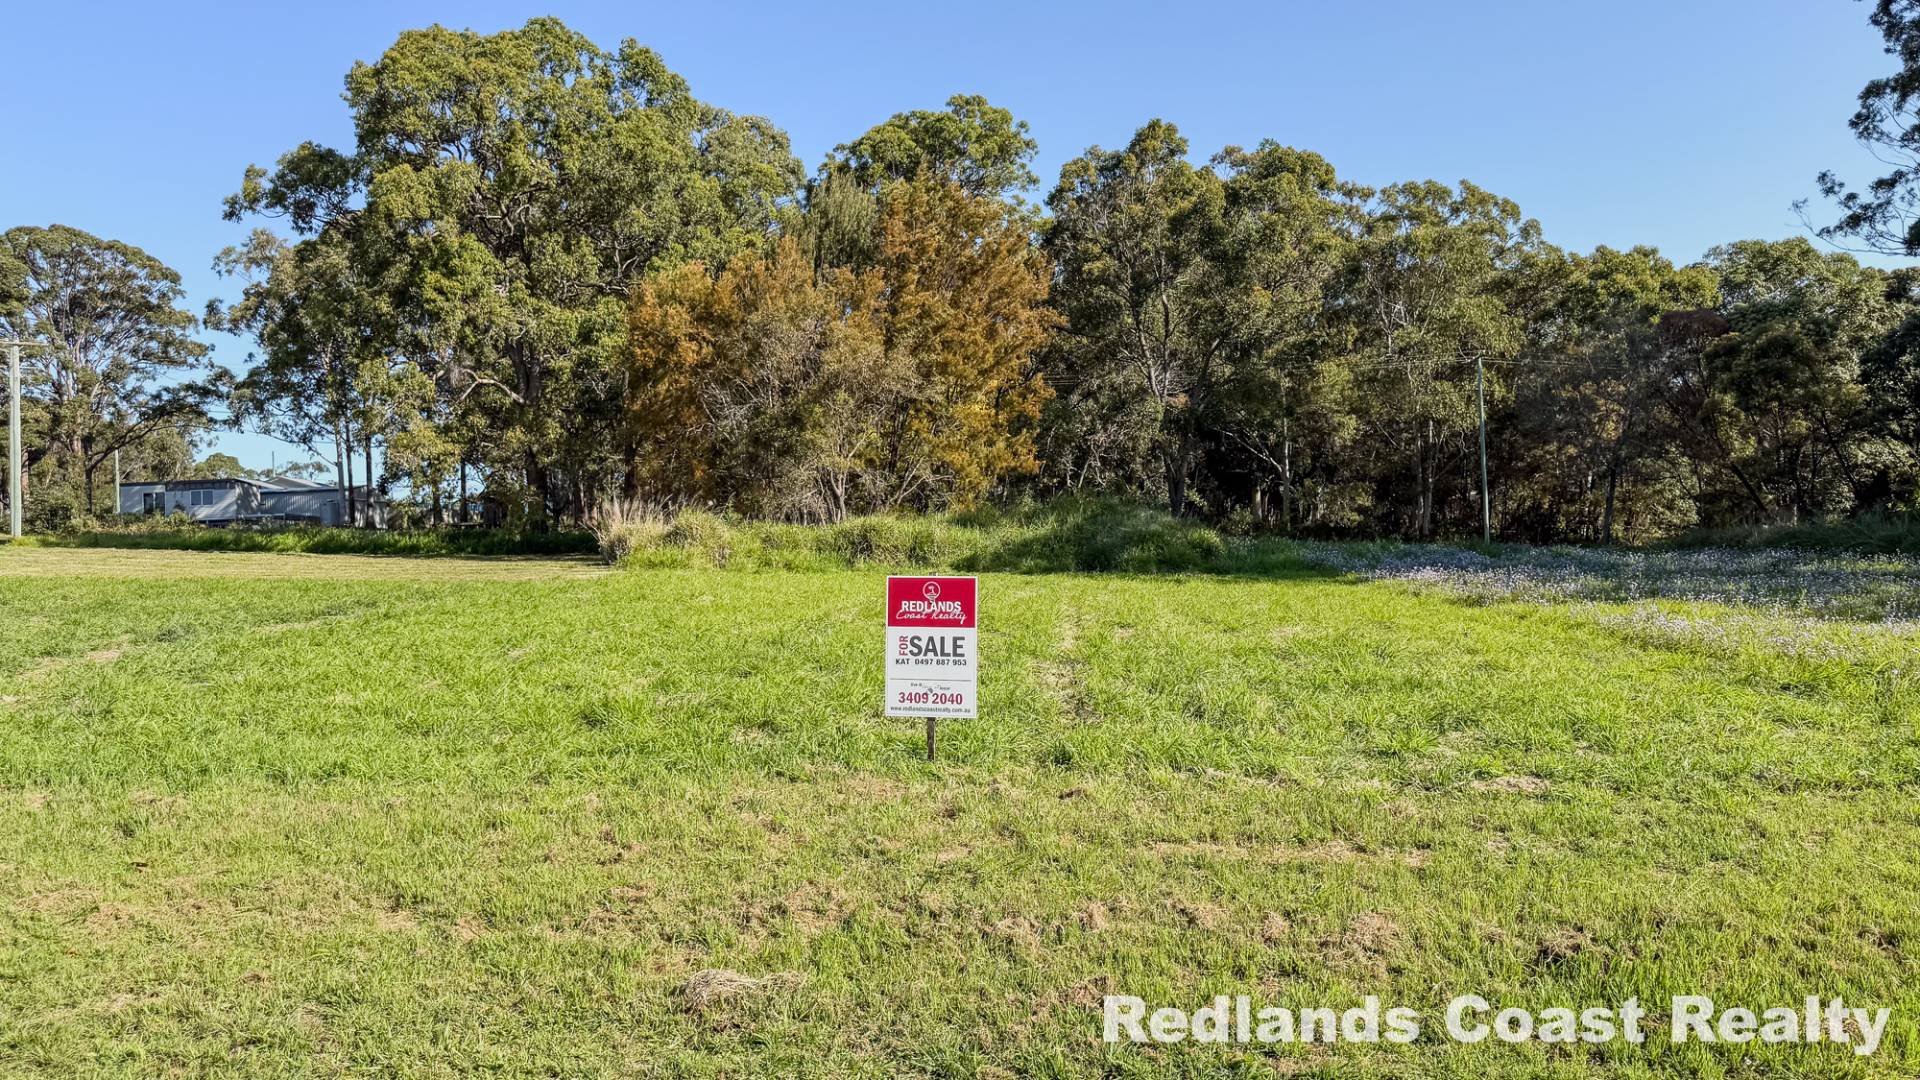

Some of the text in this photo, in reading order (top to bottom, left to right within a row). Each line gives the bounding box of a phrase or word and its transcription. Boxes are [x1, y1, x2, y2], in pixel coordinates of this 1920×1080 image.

[901, 600, 962, 613] REDLANDS
[896, 608, 967, 625] Coast Realty
[898, 635, 966, 658] FOR SALE
[895, 658, 911, 666] KAT
[914, 658, 934, 666] 0497
[898, 692, 963, 706] 3409 2040
